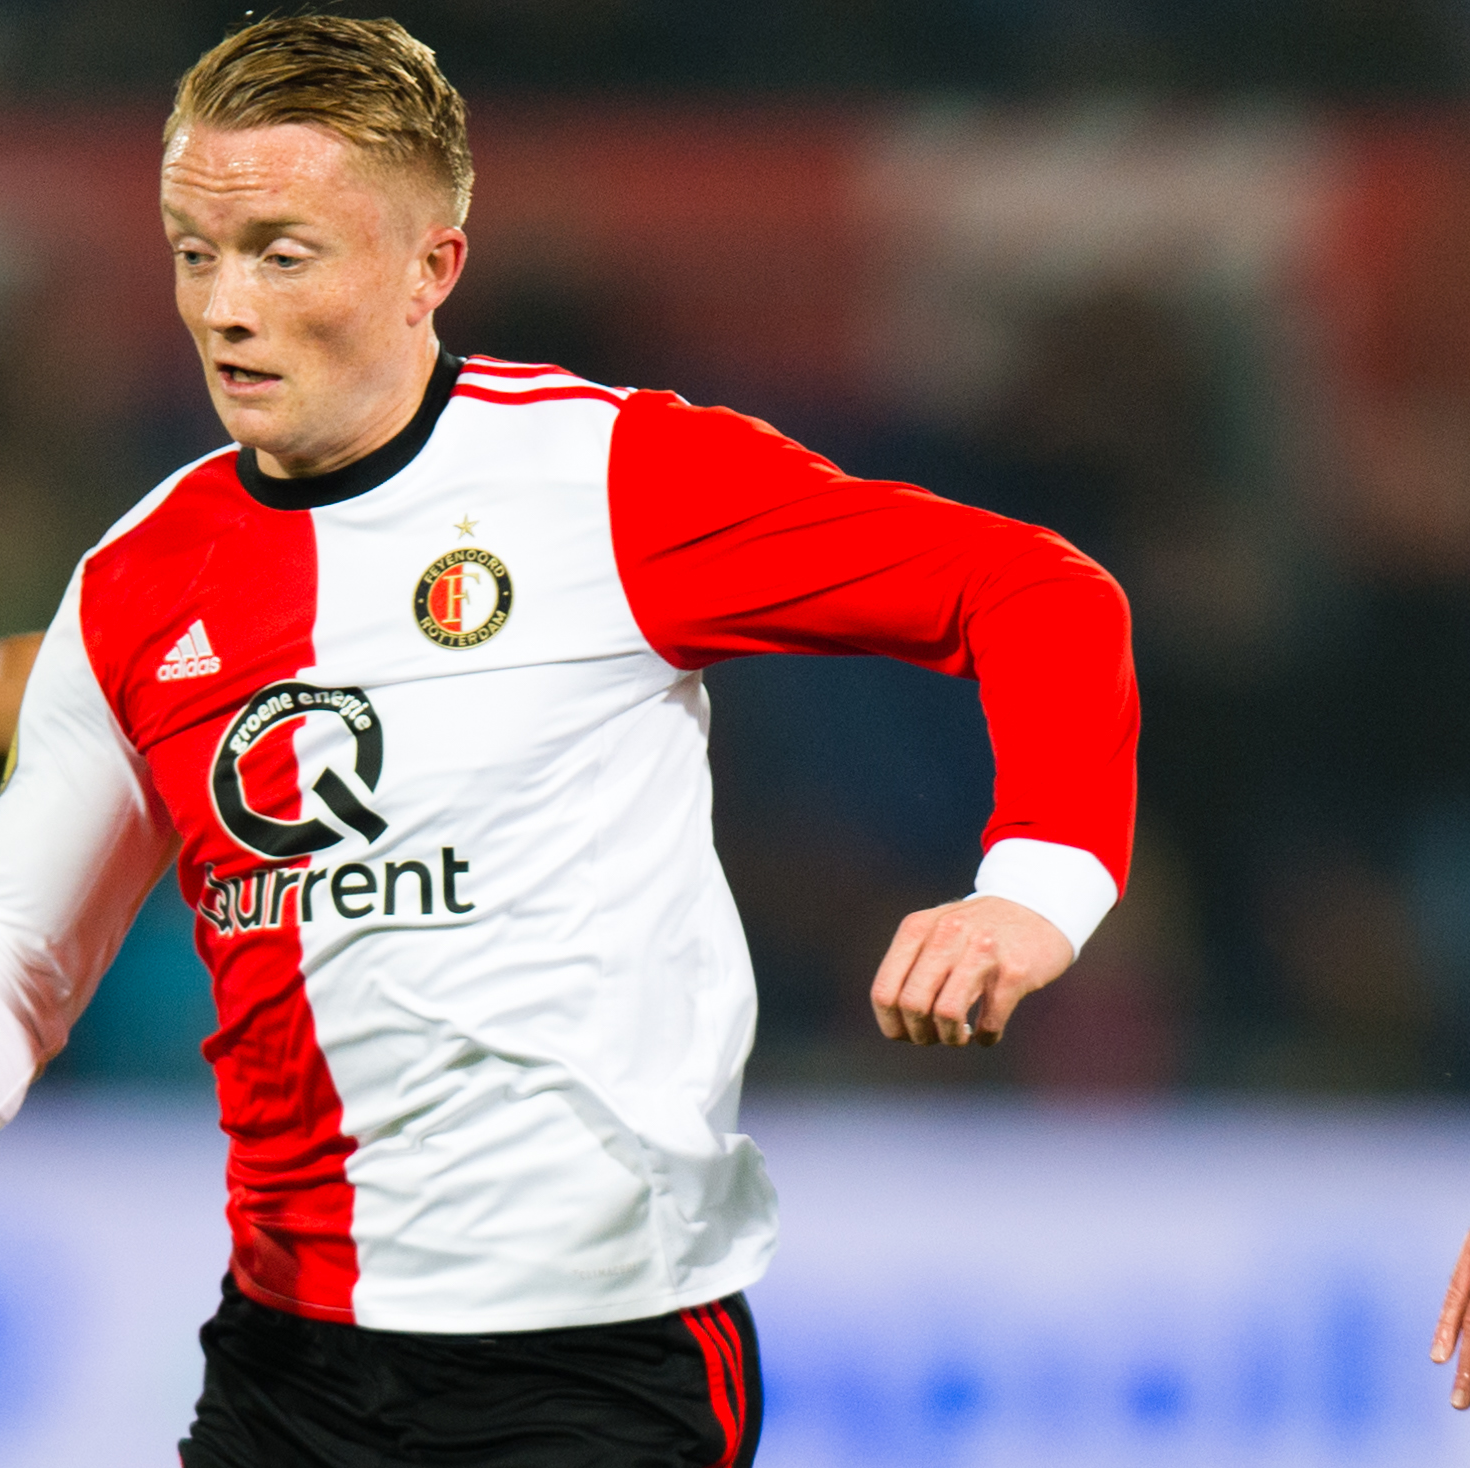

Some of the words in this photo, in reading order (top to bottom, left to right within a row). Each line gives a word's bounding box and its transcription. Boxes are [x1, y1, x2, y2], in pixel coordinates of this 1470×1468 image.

[423, 549, 506, 584] FEYENOORD
[420, 610, 507, 646] ROTTERDAM
[157, 656, 221, 682] adidas
[229, 692, 295, 754] groene
